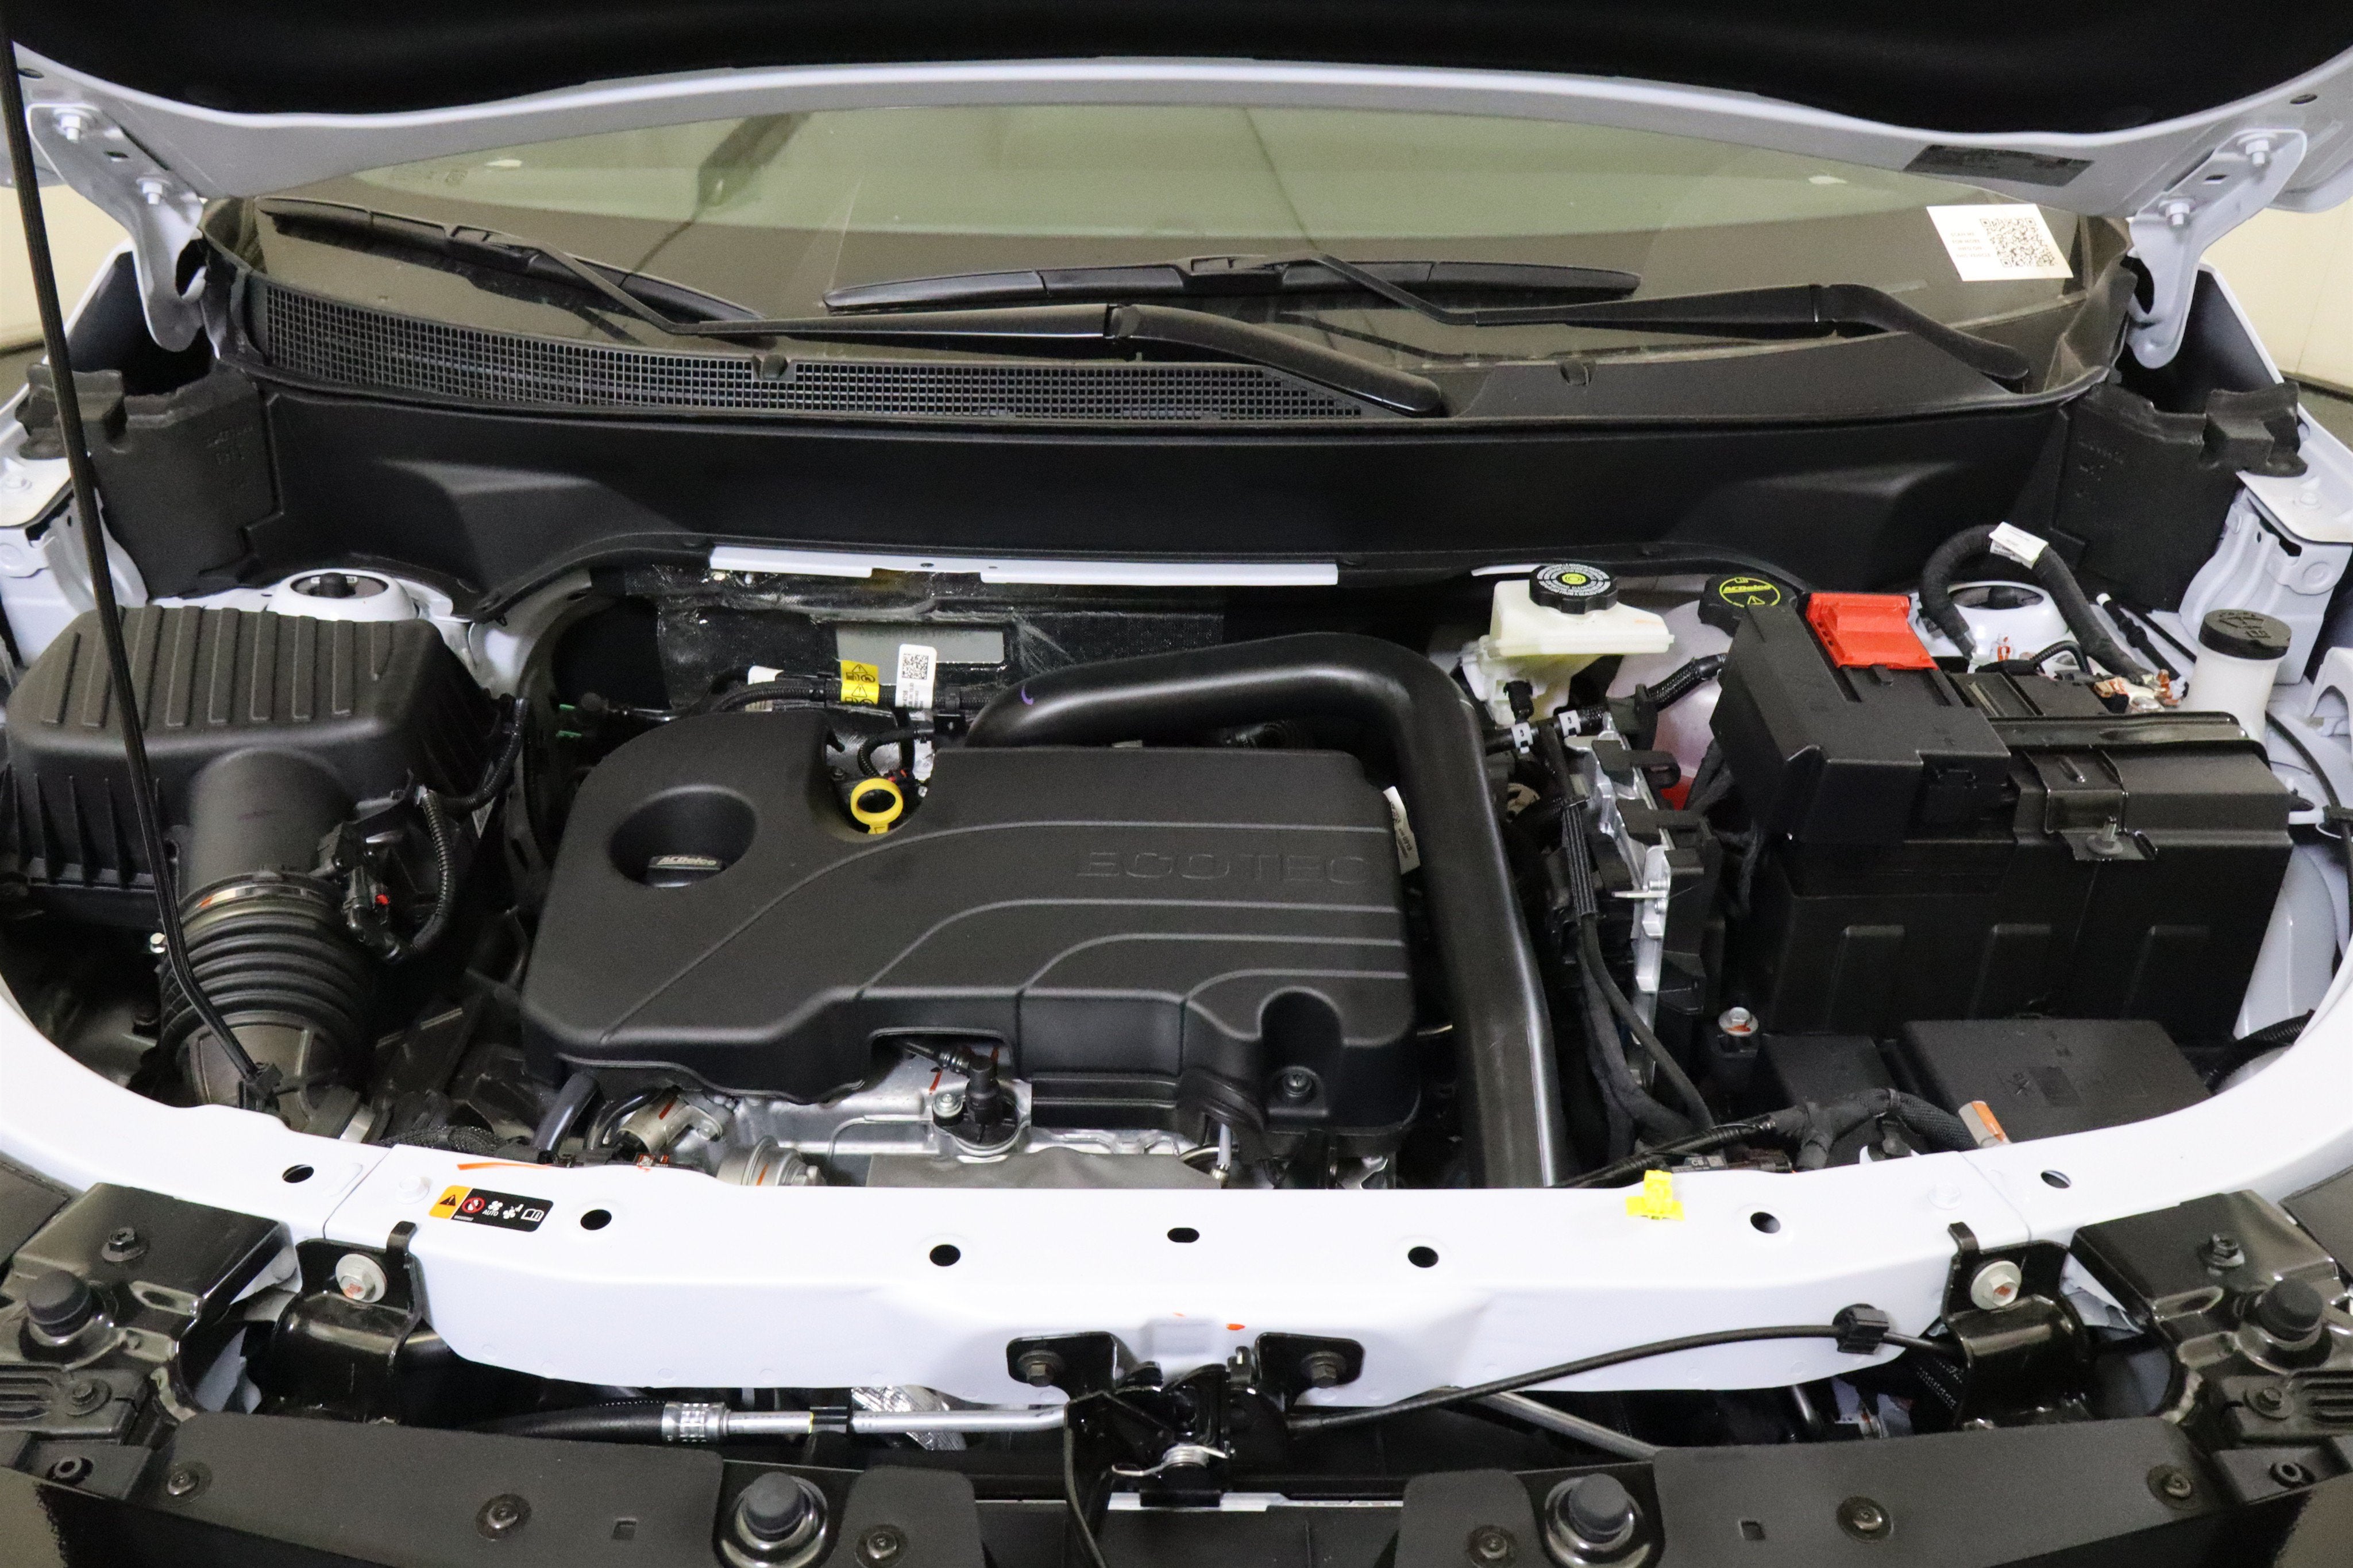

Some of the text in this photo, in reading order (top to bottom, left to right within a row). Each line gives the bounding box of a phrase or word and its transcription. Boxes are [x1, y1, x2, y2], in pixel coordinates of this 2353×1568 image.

[1723, 585, 1772, 593] ACDelco
[657, 856, 717, 866] ACDelco
[1077, 852, 1369, 885] ECOTEC
